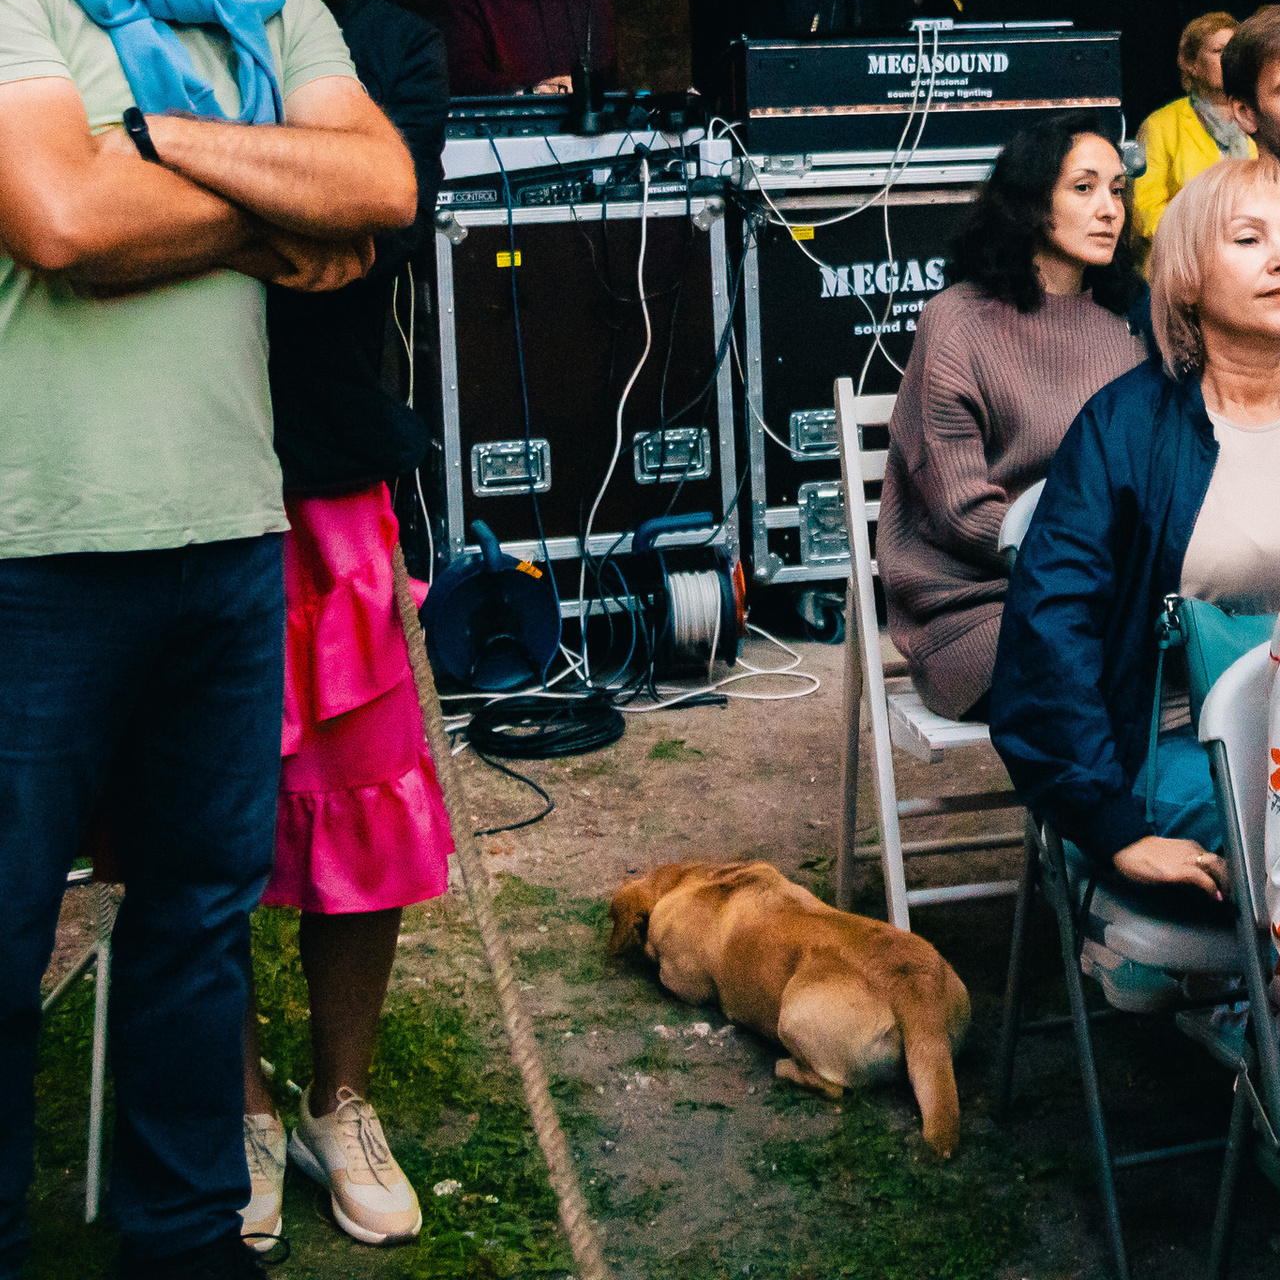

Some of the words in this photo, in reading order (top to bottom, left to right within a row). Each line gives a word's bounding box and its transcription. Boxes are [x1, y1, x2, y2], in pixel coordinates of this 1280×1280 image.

[868, 53, 1009, 75] MEGASOUND
[911, 77, 968, 87] profssional
[887, 89, 916, 98] sound
[918, 90, 926, 98] &
[456, 191, 495, 202] CONTROL
[819, 258, 946, 298] MEGAS
[854, 321, 901, 335] sound
[905, 319, 917, 332] &
